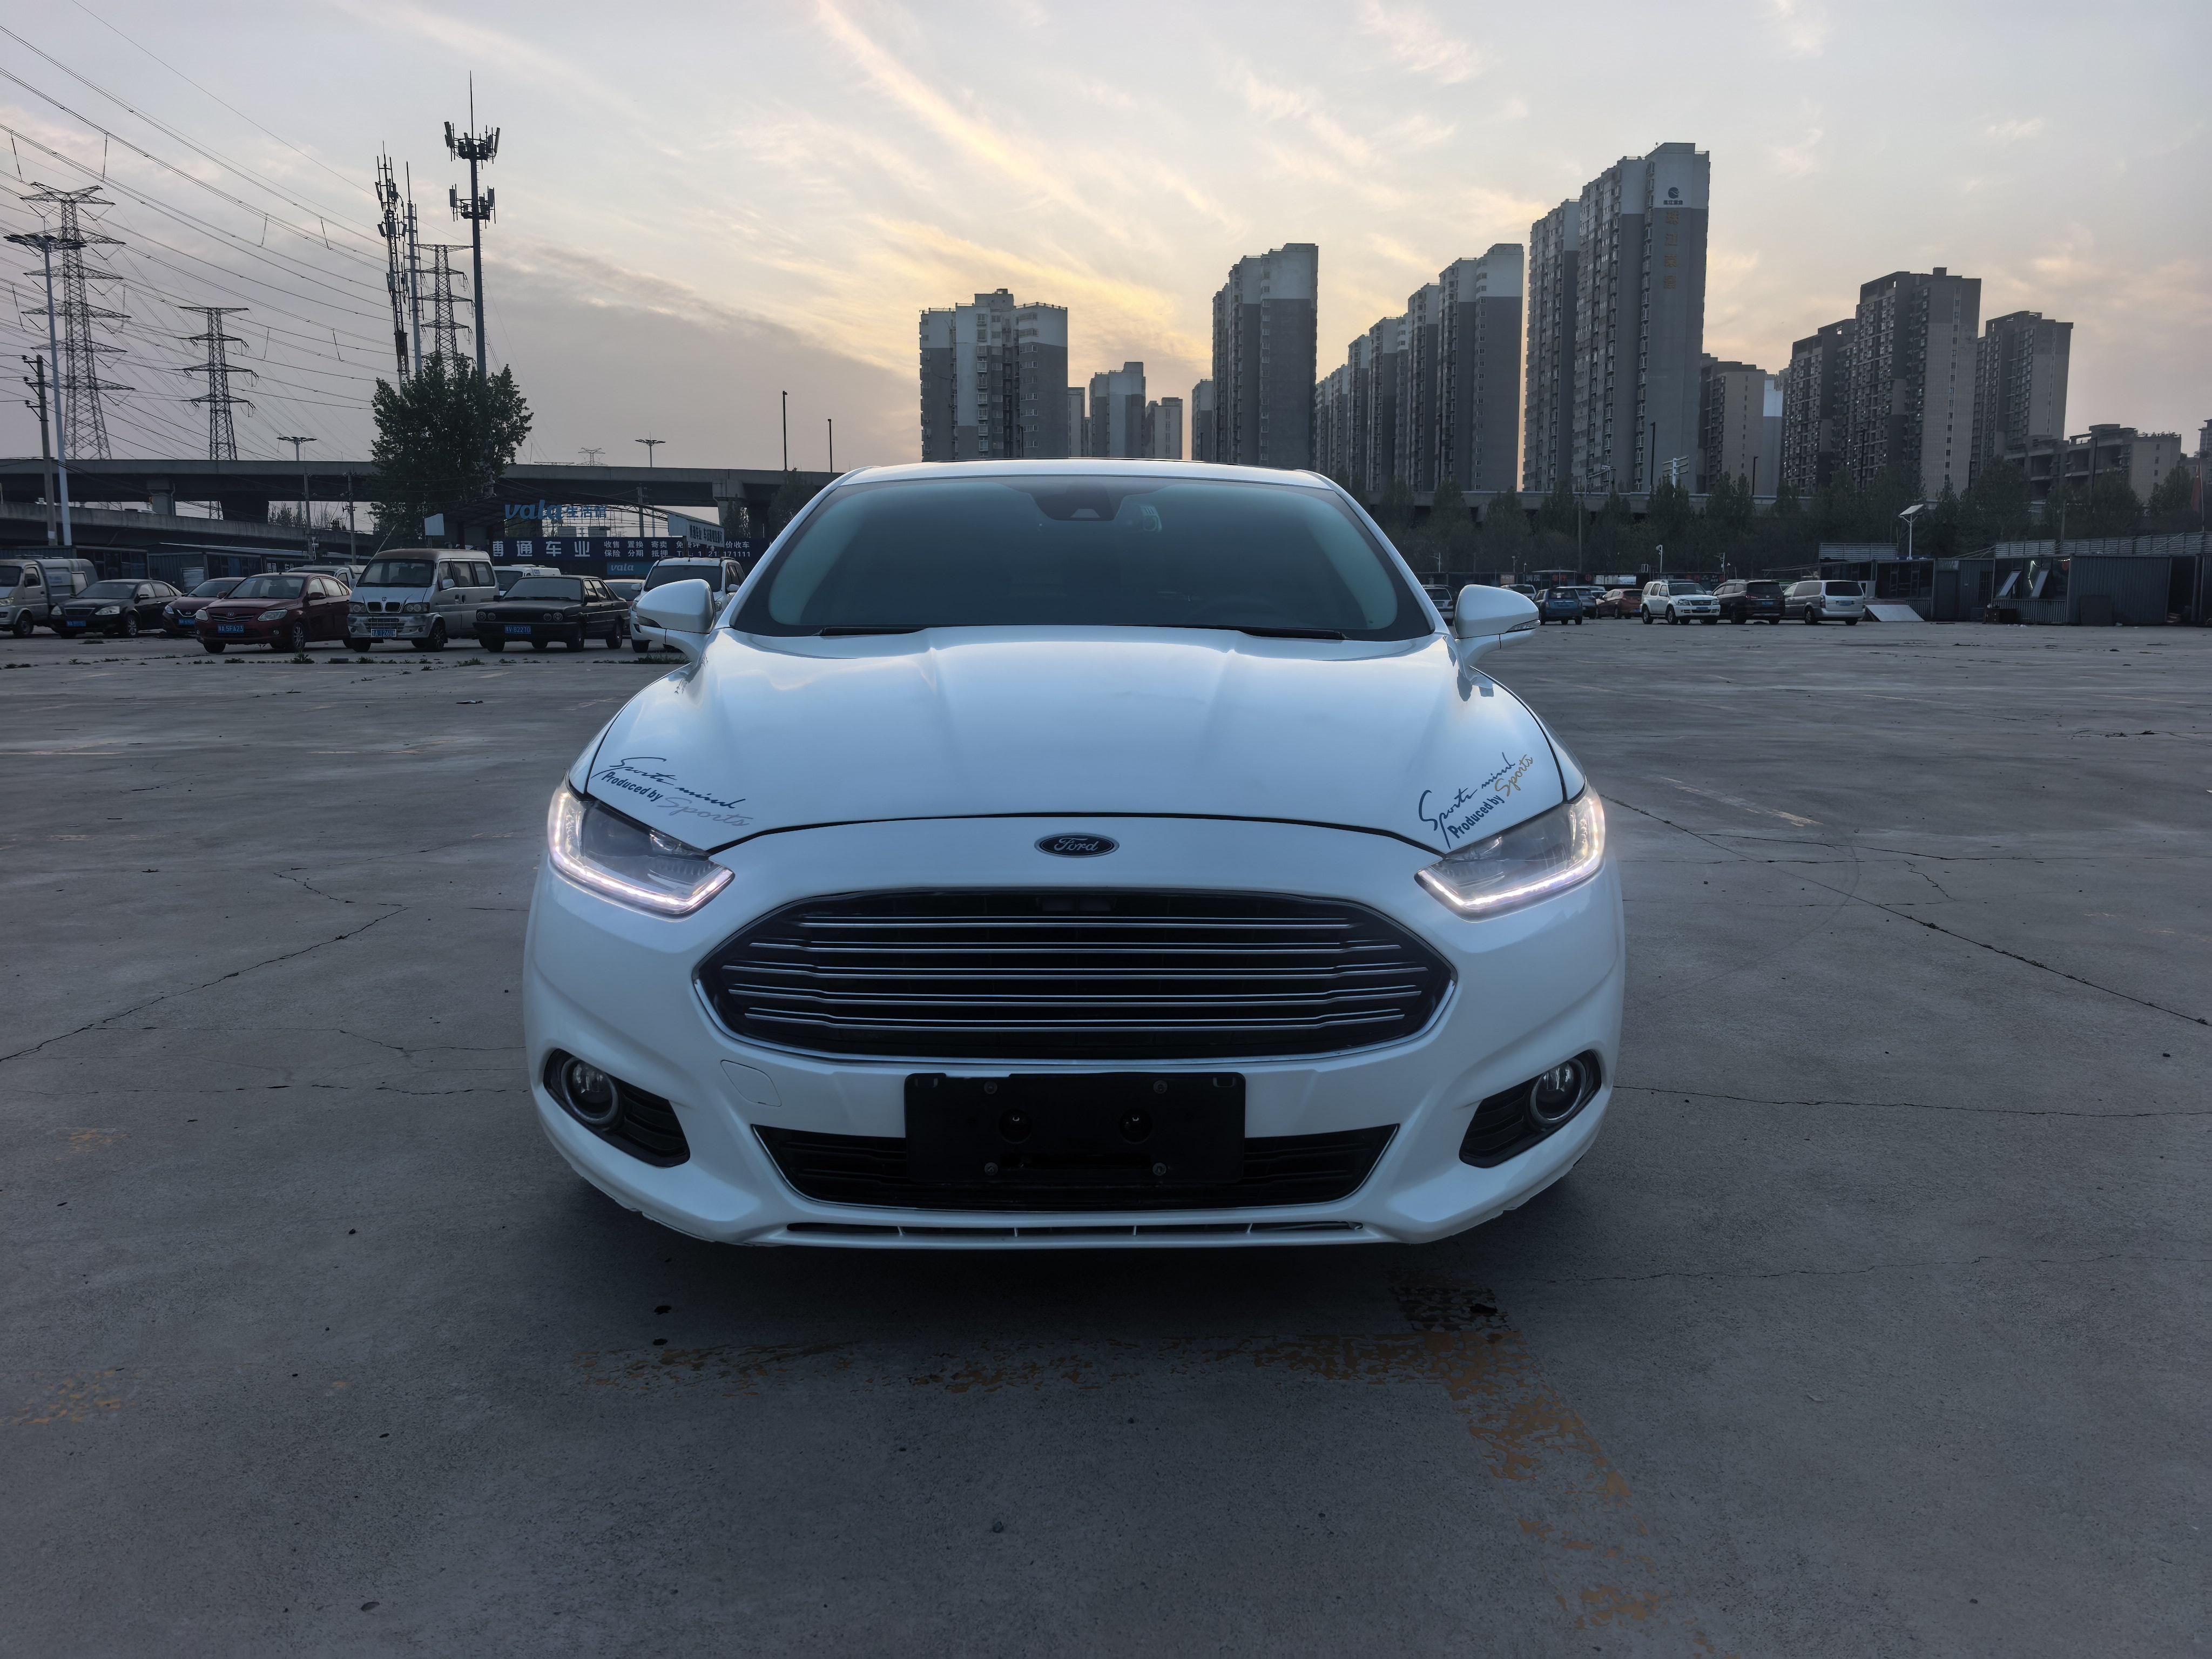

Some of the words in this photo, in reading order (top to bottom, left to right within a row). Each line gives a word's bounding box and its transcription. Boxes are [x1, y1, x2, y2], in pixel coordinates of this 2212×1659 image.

[505, 500, 563, 519] vala
[493, 541, 590, 557] 博通车业
[611, 563, 635, 571] vala
[1495, 754, 1533, 797] Sports
[601, 771, 652, 795] Produced
[646, 790, 664, 802] by
[656, 797, 754, 826] Sports
[1486, 795, 1505, 805] by
[1447, 801, 1494, 839] Produced
[1054, 838, 1099, 852] Ford
